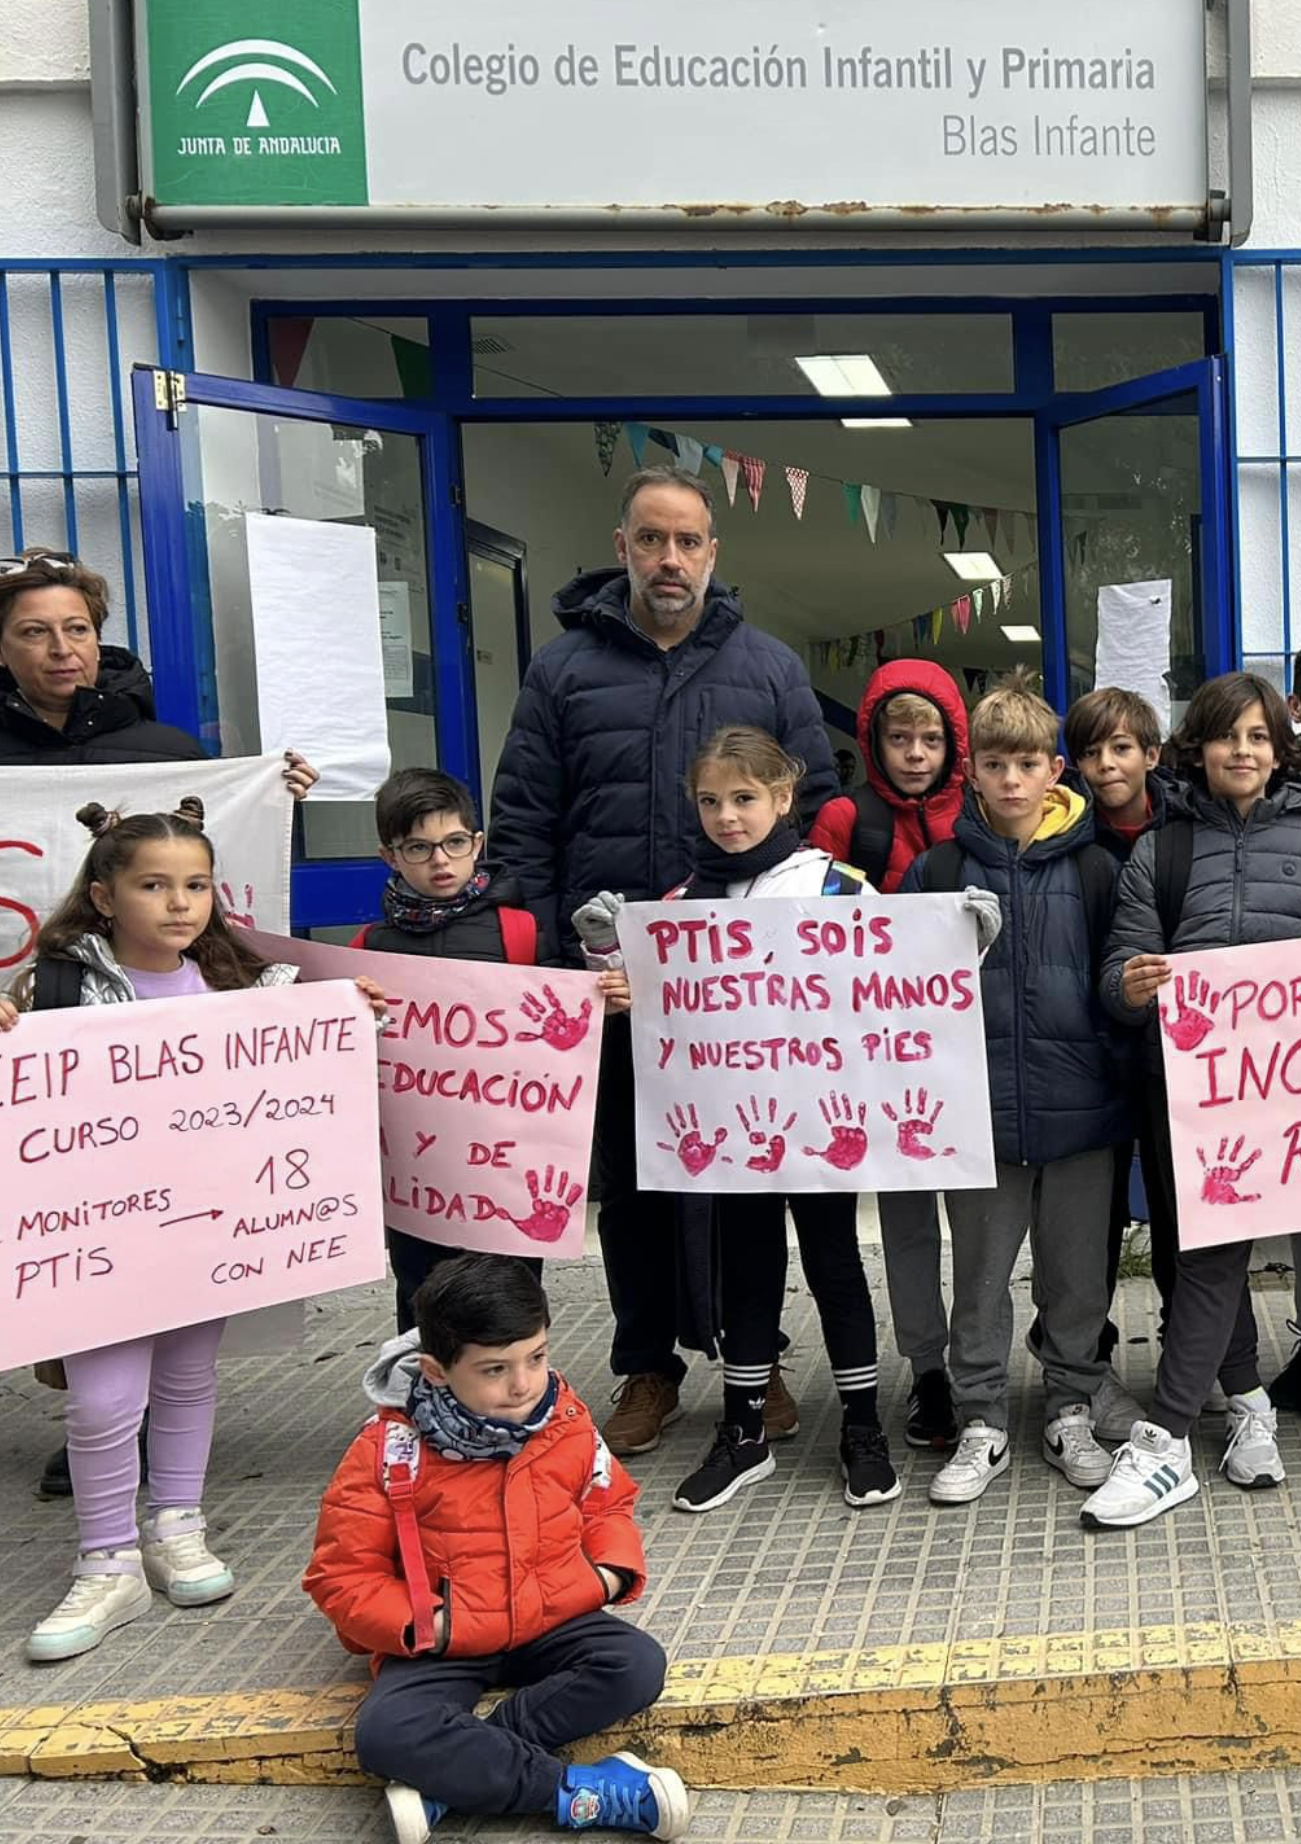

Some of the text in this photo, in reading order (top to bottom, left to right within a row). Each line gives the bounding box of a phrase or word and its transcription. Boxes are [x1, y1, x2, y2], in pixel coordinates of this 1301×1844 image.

[402, 43, 1155, 98] Colegio de Educación Infantil y Primaria
[177, 136, 341, 156] JUNTA DE ANDALUCIA
[943, 115, 1156, 158] Blas Infante
[662, 968, 975, 1015] NUESTRAS MANOS
[0, 1016, 356, 1107] EIP BLAS INFANTE
[657, 1037, 675, 1070] Y
[689, 1037, 843, 1072] NUESTROS
[19, 1090, 334, 1163] CURSO 2023/2024
[255, 1148, 310, 1195] 18
[467, 1141, 516, 1168] DE
[232, 1194, 358, 1238] ALUMN@S
[211, 1257, 264, 1284] CON
[287, 1235, 347, 1269] NEE
